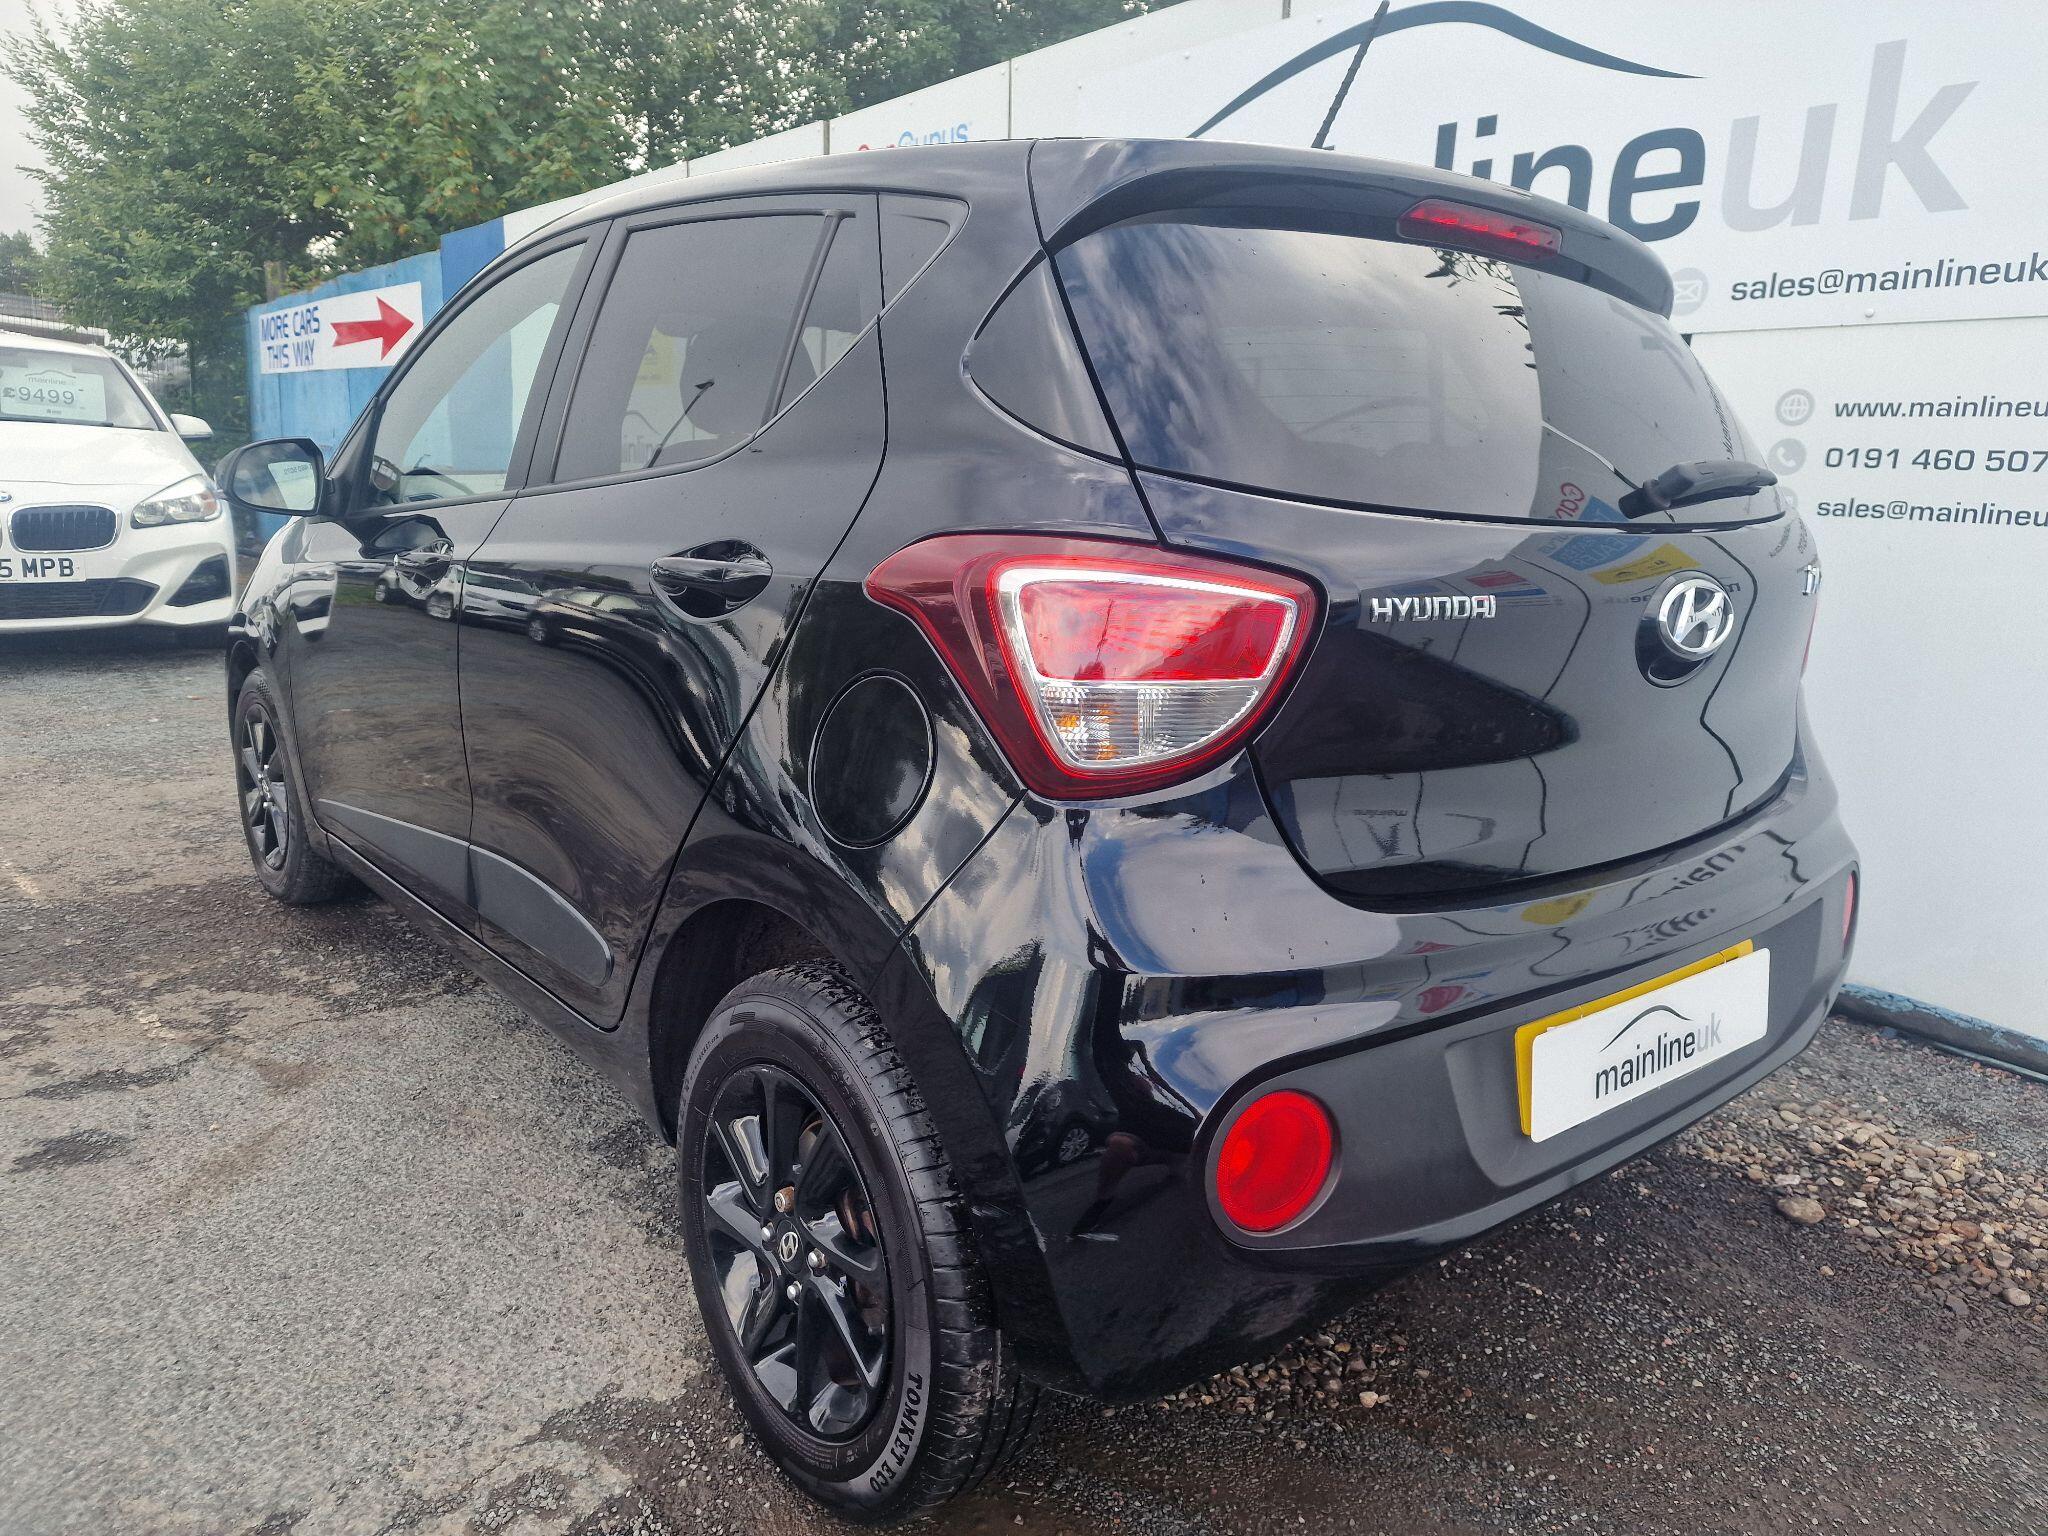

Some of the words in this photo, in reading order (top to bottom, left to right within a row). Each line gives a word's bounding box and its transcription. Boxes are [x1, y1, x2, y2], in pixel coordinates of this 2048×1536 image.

[261, 313, 289, 342] MORE
[292, 306, 321, 337] CARS
[266, 343, 290, 369] THIS
[292, 339, 315, 367] WAY
[1825, 448, 1900, 469] 0191
[1912, 449, 1976, 471] 460
[1984, 449, 2048, 473] 507
[21, 557, 74, 578] MPB
[1370, 594, 1497, 623] HYUNDAI
[1595, 1011, 1722, 1100] mainlineuk
[890, 1372, 923, 1467] TOMKET
[869, 1460, 897, 1493] ECO
